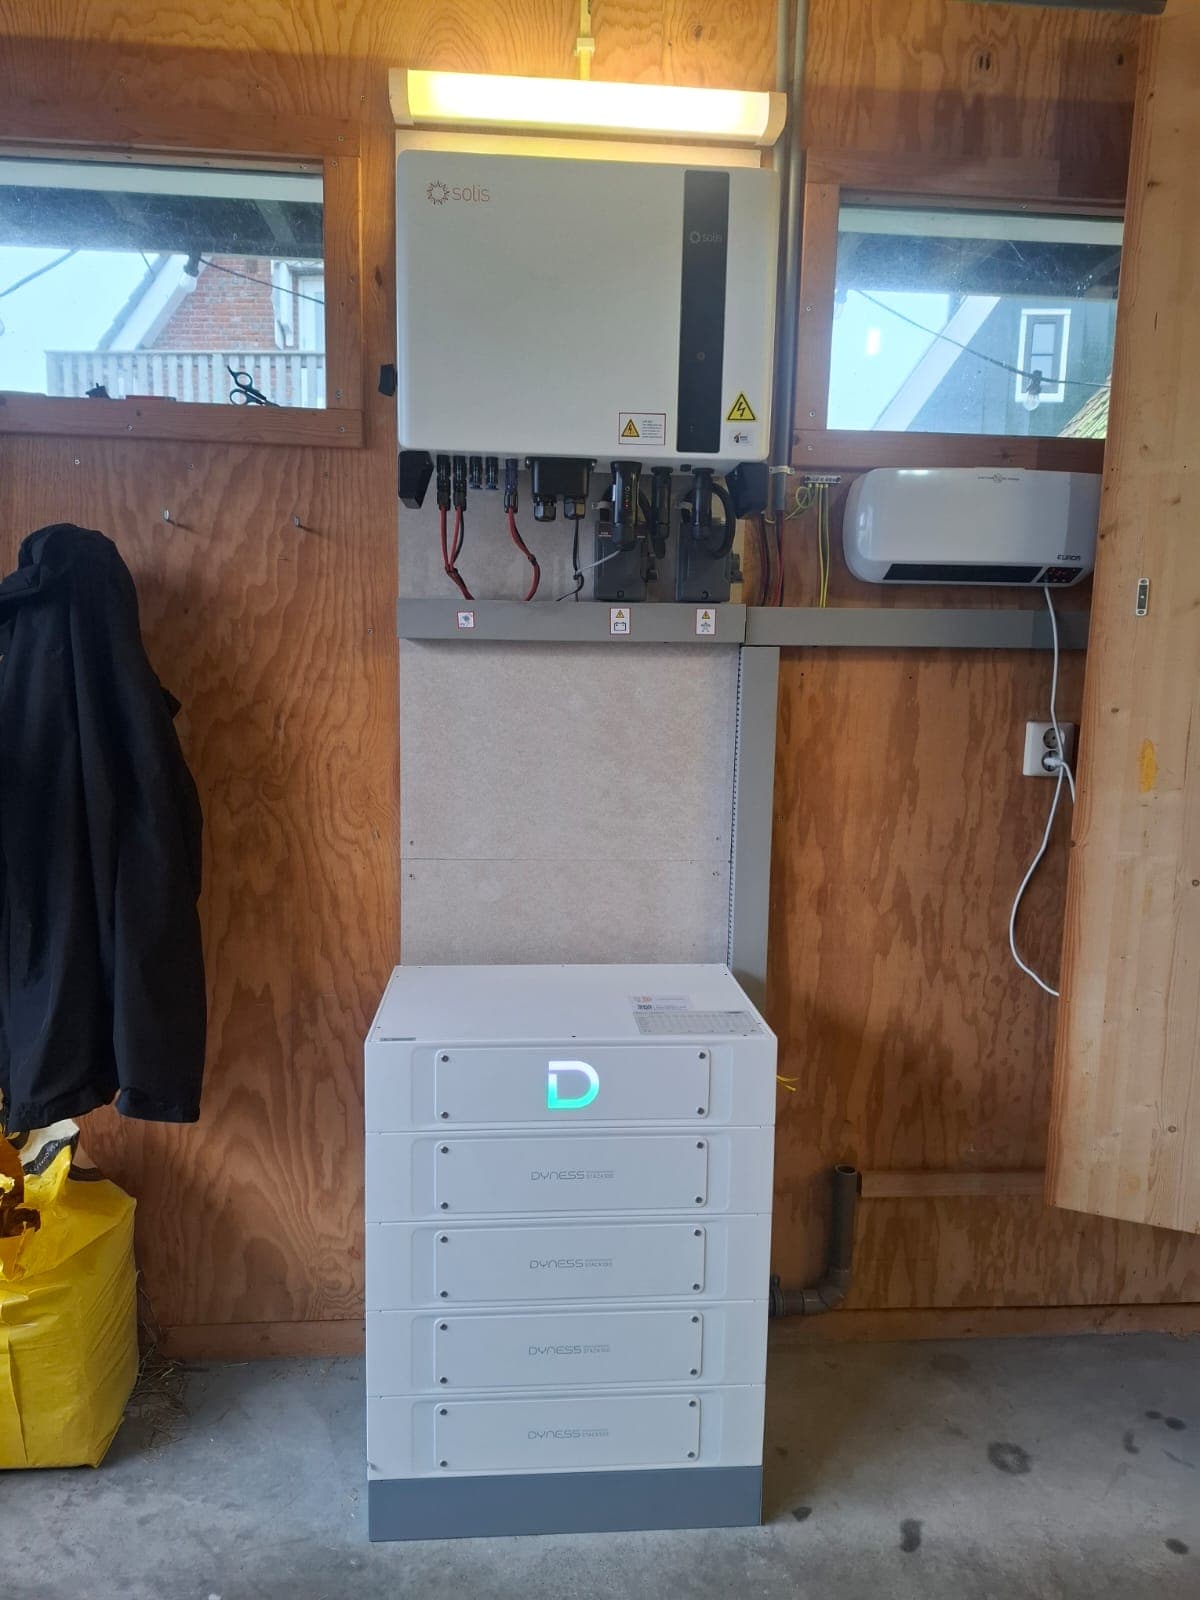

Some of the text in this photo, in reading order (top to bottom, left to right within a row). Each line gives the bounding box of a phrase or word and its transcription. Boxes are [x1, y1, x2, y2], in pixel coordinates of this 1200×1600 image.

[452, 184, 490, 202] solis
[548, 1060, 600, 1109] D
[531, 1170, 585, 1180] DYNESS
[530, 1259, 584, 1269] DYNESS
[528, 1345, 582, 1355] DYNESS
[528, 1430, 581, 1440] DYNESS
